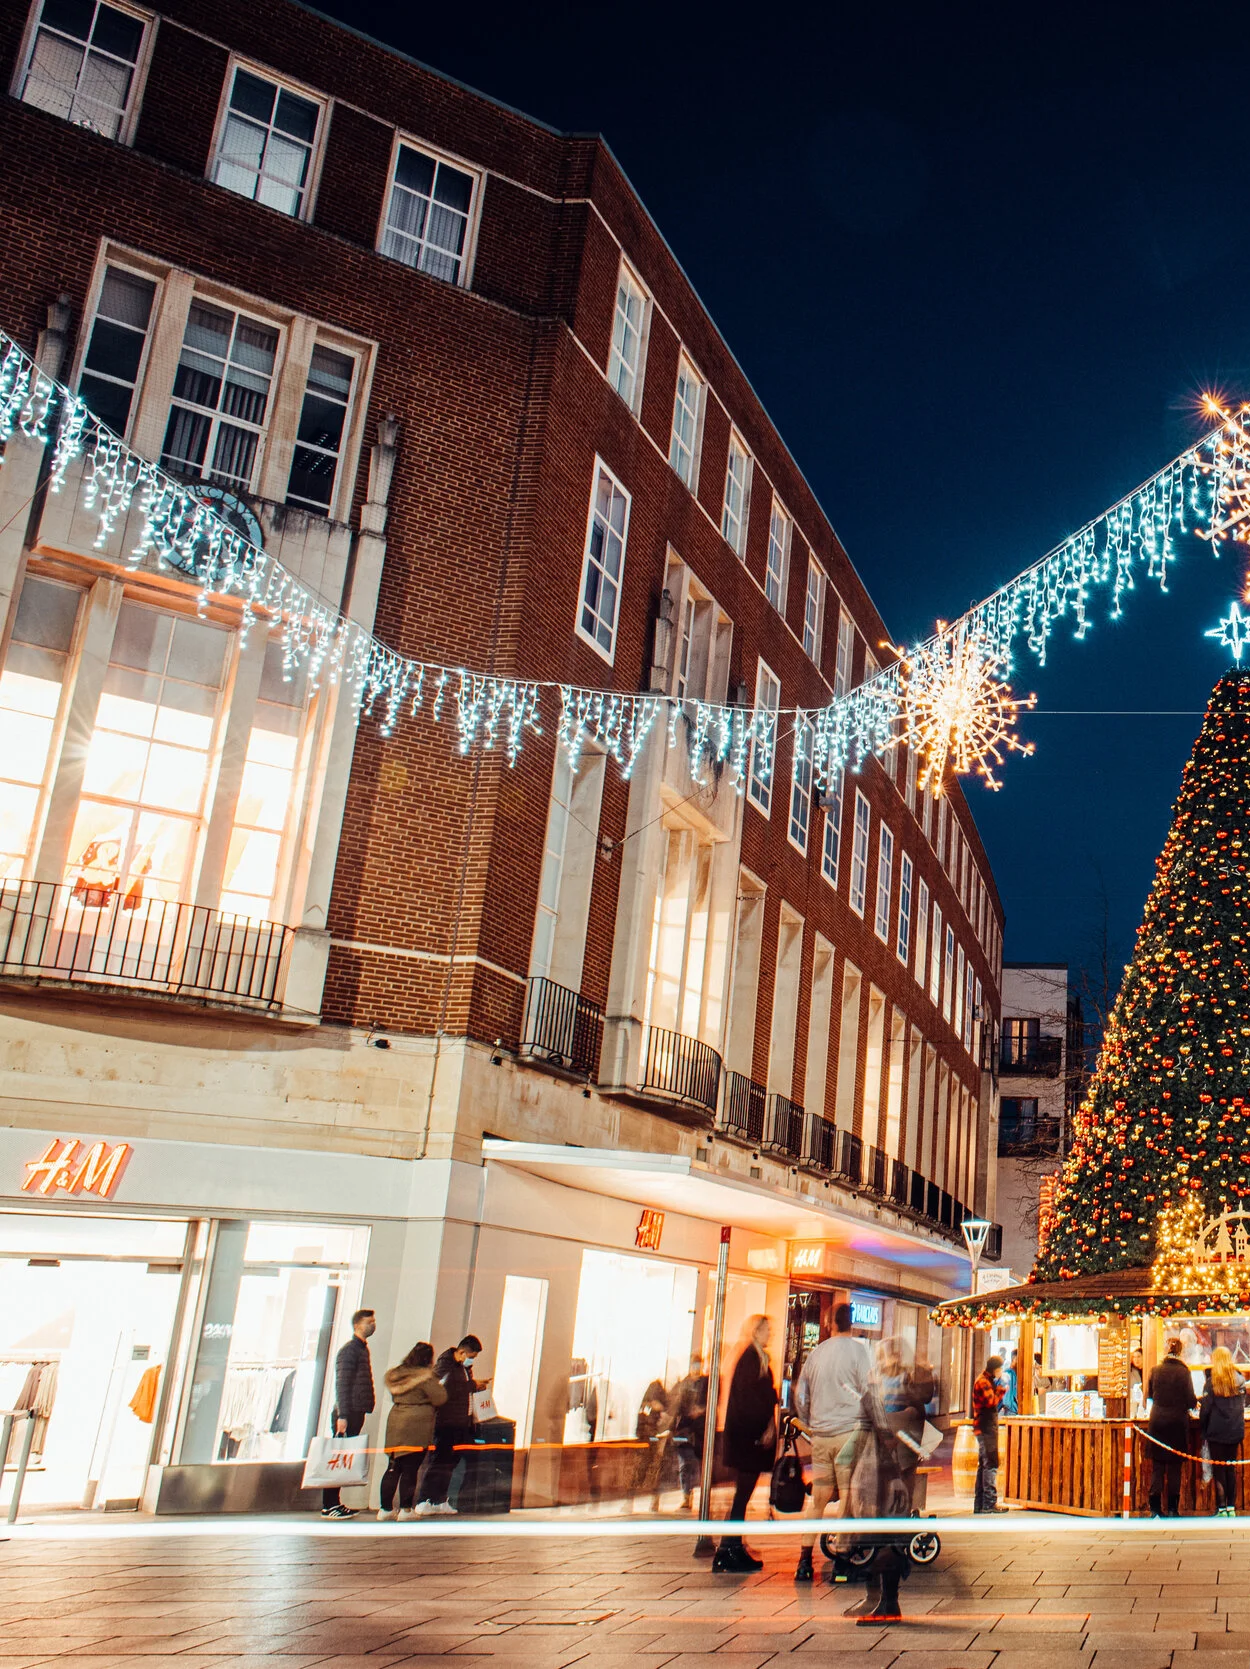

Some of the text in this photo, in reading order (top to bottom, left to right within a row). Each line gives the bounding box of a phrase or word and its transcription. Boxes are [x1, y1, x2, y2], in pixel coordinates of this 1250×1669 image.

[21, 1139, 128, 1198] H&M
[635, 1209, 665, 1250] H&M
[1039, 1174, 1058, 1246] Princ
